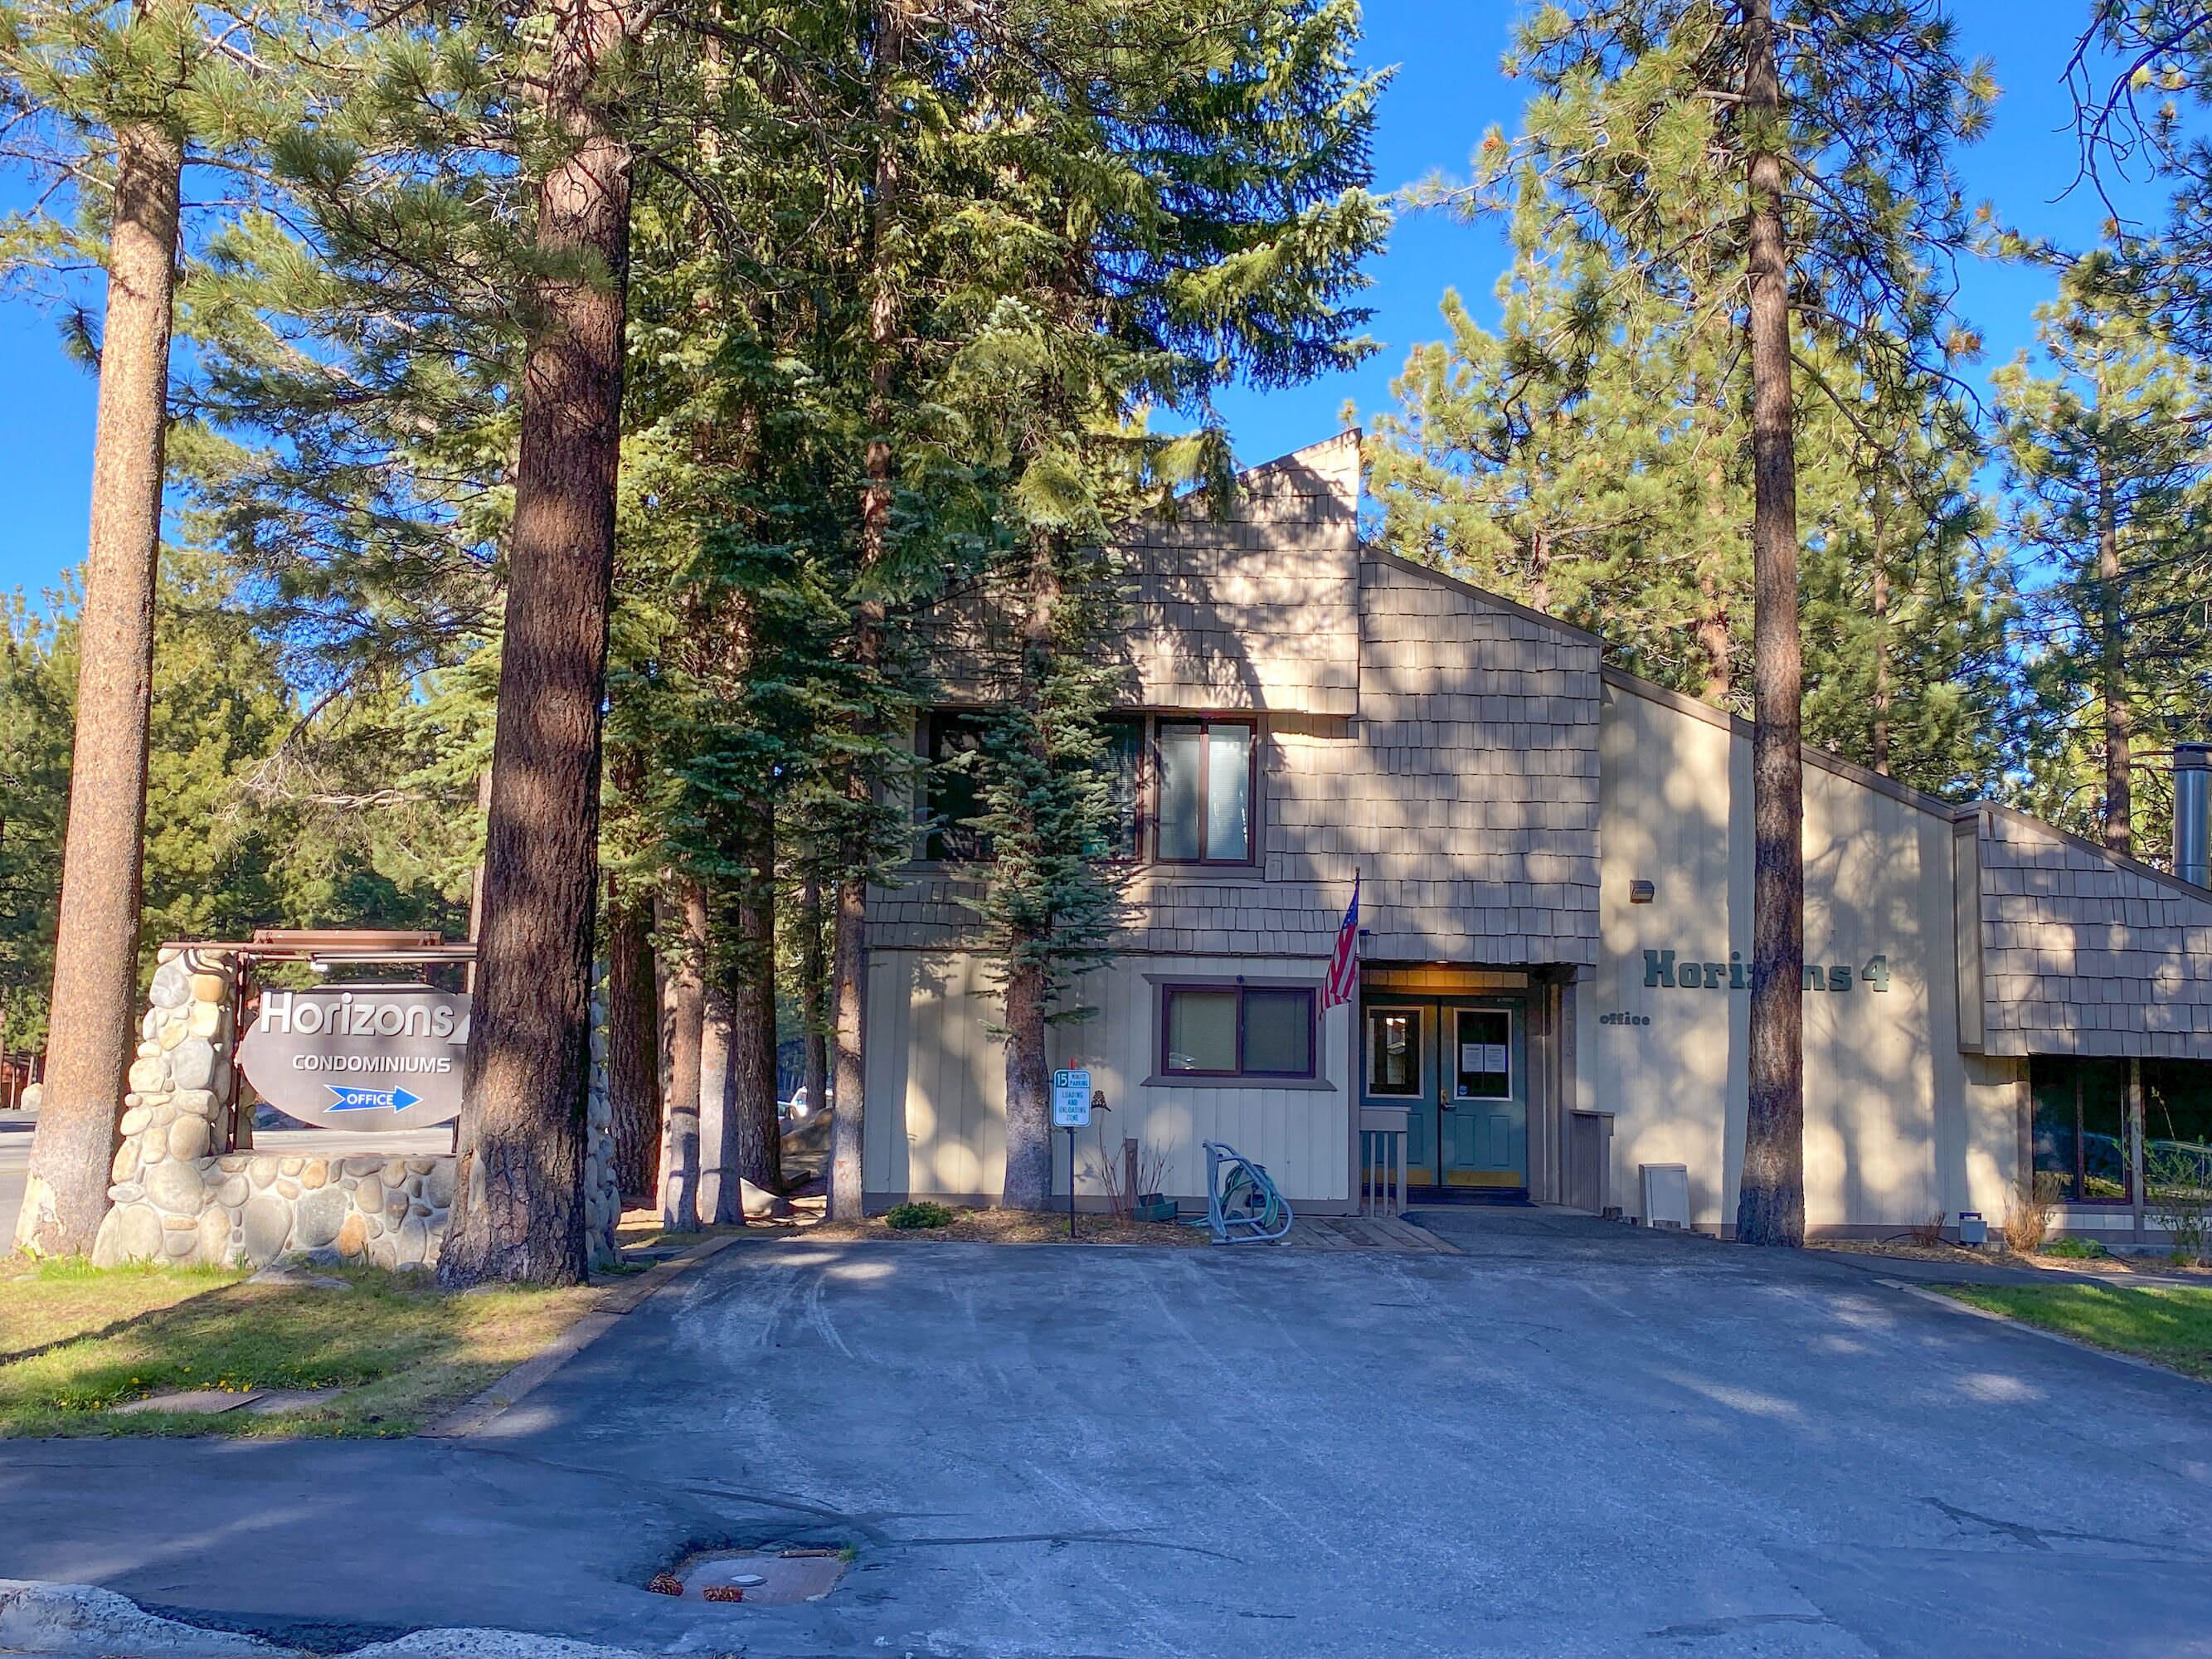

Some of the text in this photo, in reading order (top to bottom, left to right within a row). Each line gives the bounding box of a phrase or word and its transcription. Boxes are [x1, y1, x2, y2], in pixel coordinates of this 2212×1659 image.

[1643, 950, 1890, 993] Horins 4
[260, 991, 454, 1037] Horizons
[1599, 1012, 1650, 1025] office
[292, 1054, 451, 1073] CONDOMINIUMS
[1057, 1073, 1067, 1087] 15
[346, 1093, 394, 1107] OFFICE
